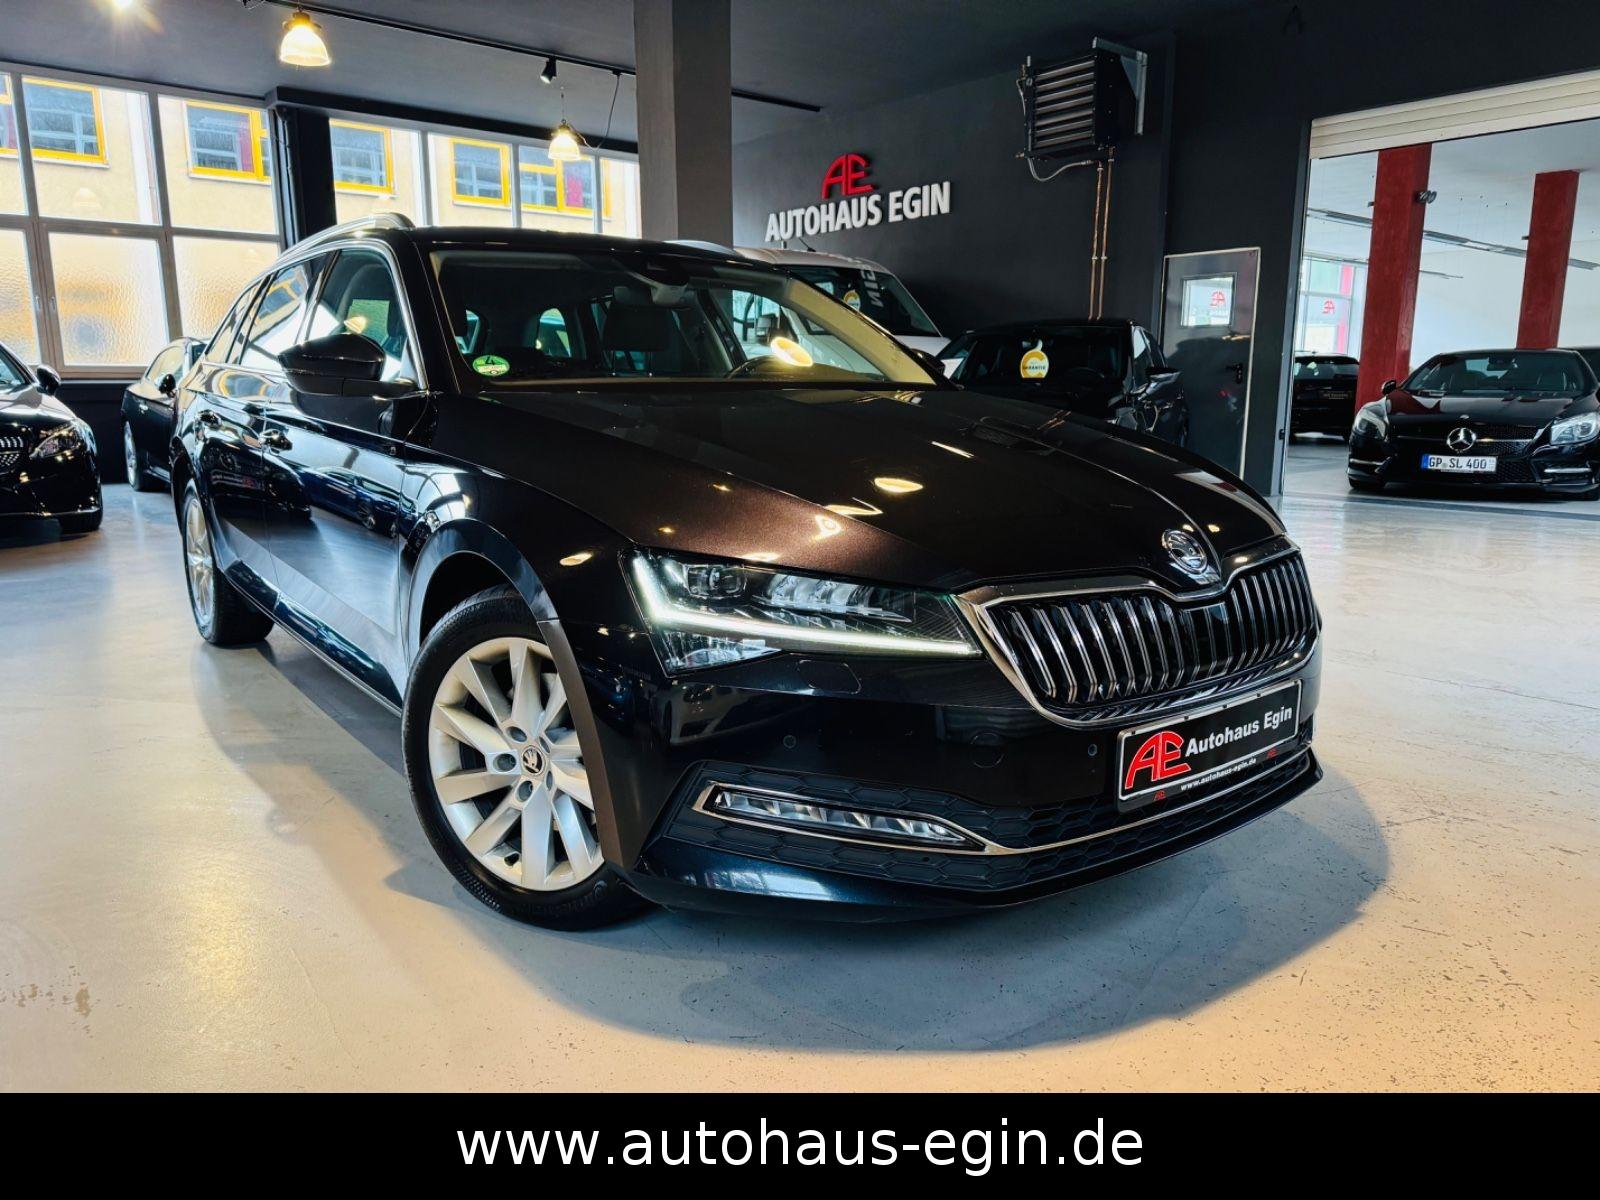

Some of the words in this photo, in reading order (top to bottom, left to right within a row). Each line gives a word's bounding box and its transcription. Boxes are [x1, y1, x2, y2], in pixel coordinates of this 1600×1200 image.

[764, 194, 883, 243] AUTOHAUS
[888, 181, 951, 223] EGIN
[1429, 457, 1443, 467] GP
[1449, 458, 1462, 468] SL
[1466, 459, 1487, 469] 400
[1185, 718, 1260, 758] Autohaus
[1263, 706, 1293, 732] Egin
[1181, 757, 1258, 792] www.autohaus-egin.de
